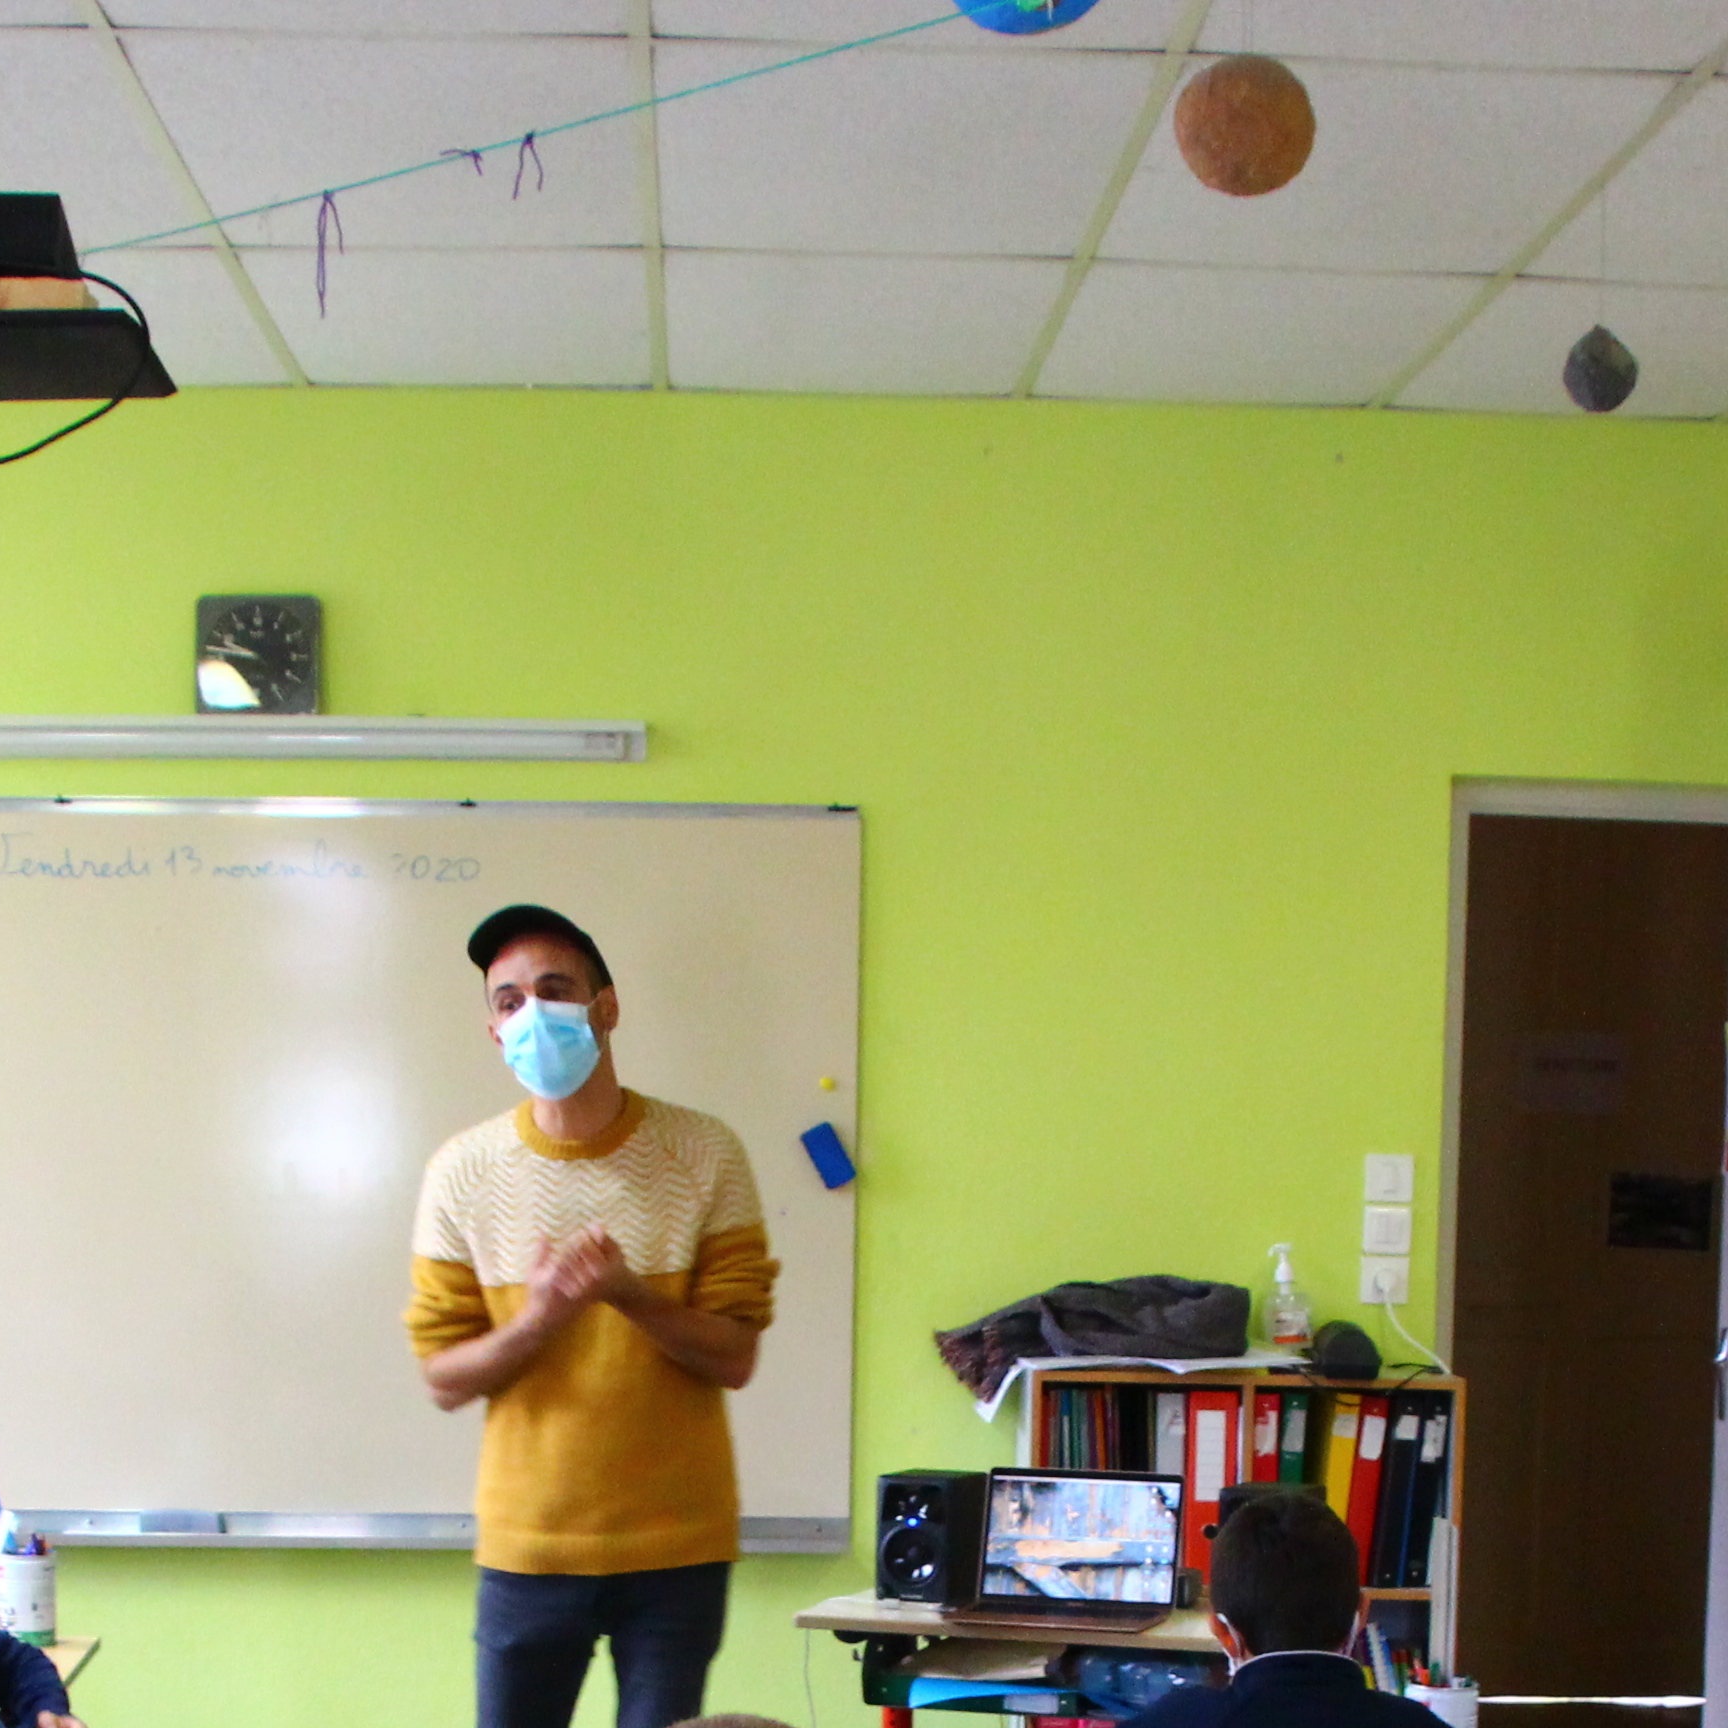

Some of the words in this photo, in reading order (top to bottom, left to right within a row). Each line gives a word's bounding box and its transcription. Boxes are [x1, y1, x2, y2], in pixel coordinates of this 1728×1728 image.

[165, 845, 202, 876] 13
[212, 838, 368, 880] novembre
[393, 852, 482, 883] 2020
